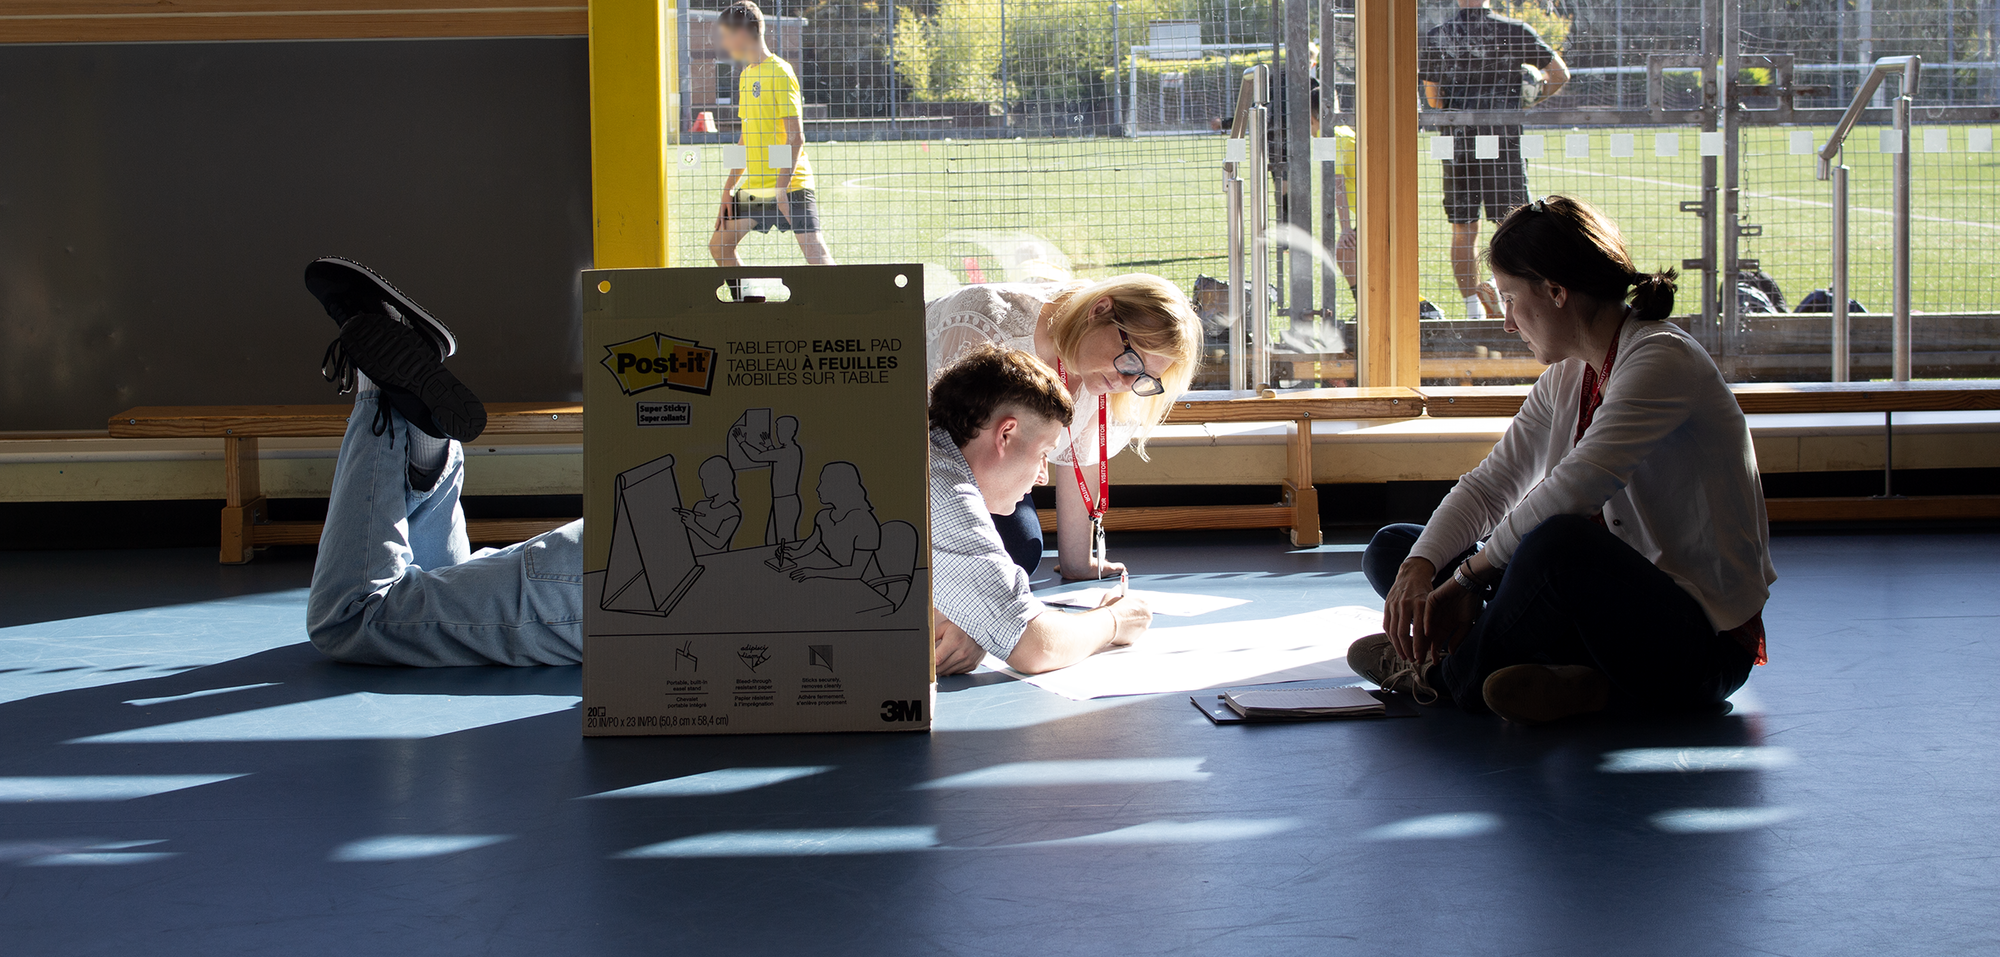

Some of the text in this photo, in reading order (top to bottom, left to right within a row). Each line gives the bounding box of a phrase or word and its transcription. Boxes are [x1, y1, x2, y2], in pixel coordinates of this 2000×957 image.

[726, 338, 902, 355] TABLETOP EASEL PAD
[726, 355, 898, 372] TABLEAU À FEUILLES
[727, 371, 889, 386] MOBILES SUR TABLE
[1582, 370, 1593, 396] VISITOR
[640, 404, 687, 413] Super Sticky
[640, 414, 686, 424] Super collants
[1080, 481, 1091, 503] VISITOR
[587, 706, 598, 717] 20
[880, 699, 922, 722] 3M
[587, 714, 729, 728] 20 IN/PO x 23 IN/PO (50,8 cm x 58,4 cm)
